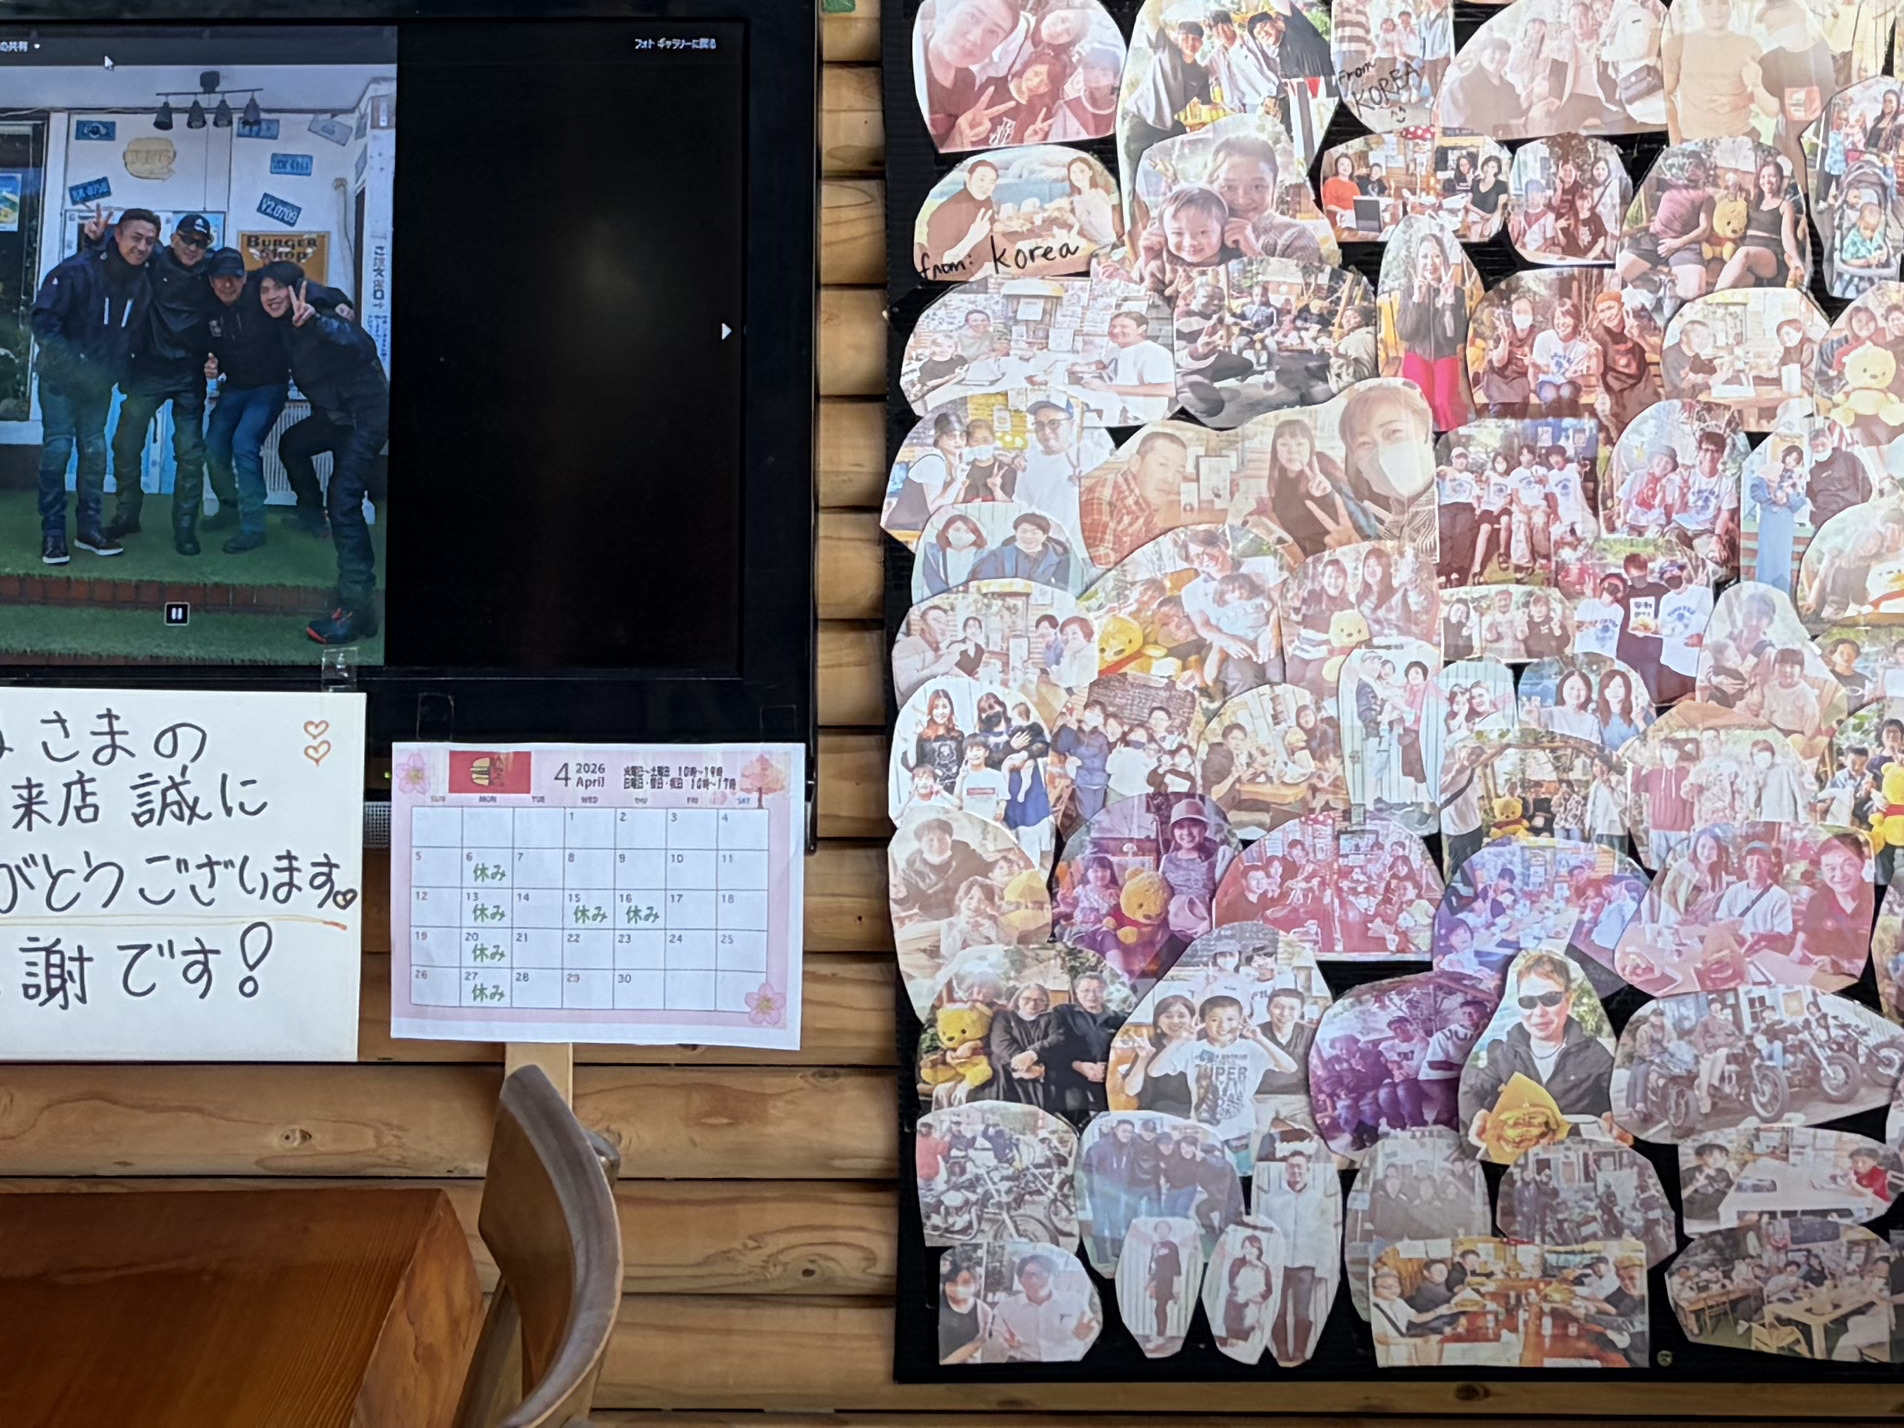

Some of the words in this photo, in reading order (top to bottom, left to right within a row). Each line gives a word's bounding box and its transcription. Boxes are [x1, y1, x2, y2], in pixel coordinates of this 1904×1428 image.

[1352, 64, 1421, 111] KOREA
[991, 236, 1080, 275] korea
[554, 762, 572, 787] 4
[575, 762, 606, 774] 2026
[575, 776, 605, 790] April
[473, 863, 506, 883] 休み
[472, 903, 506, 922] 休み
[573, 905, 608, 924] 休み
